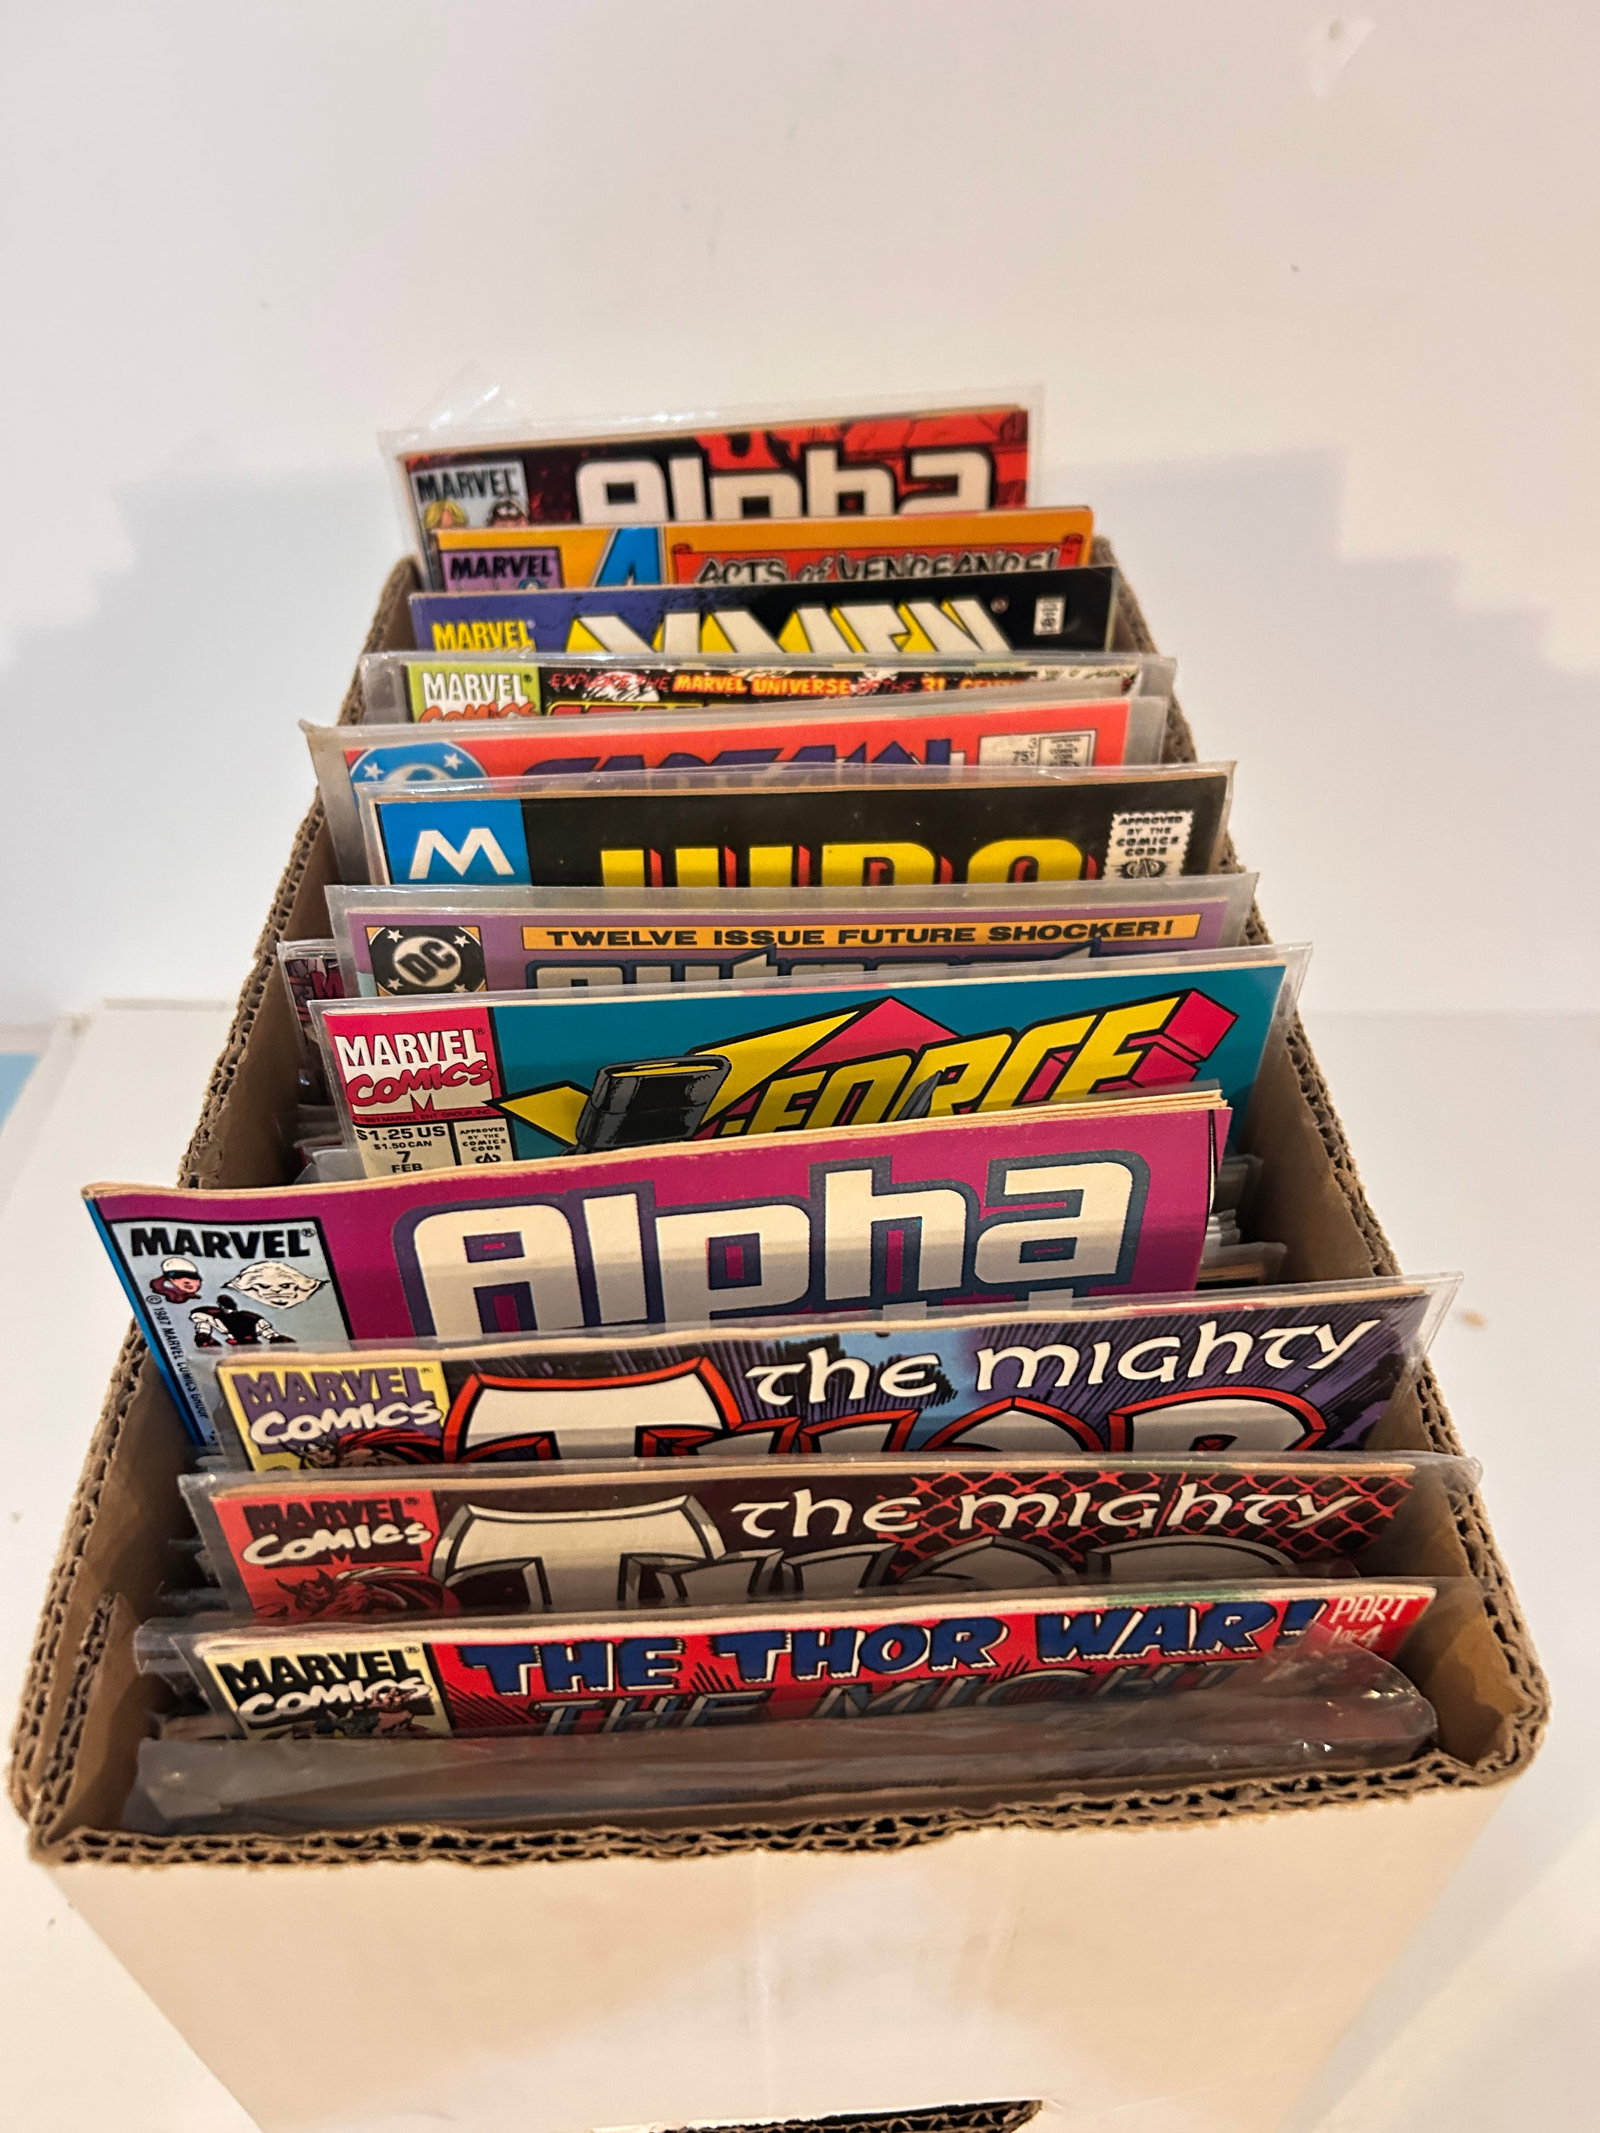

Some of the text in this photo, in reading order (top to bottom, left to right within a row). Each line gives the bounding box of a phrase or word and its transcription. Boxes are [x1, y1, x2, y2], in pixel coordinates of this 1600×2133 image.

[416, 470, 518, 501] MARVEL
[450, 555, 553, 580] MARVEL
[698, 557, 789, 585] ACTS
[432, 620, 536, 650] MARVEL
[423, 673, 529, 702] MARVEL
[672, 674, 747, 694] MARVEL
[752, 676, 851, 696] UNIVERSE
[1119, 816, 1183, 825] APPROVED
[1116, 836, 1179, 847] COMICS
[1125, 847, 1168, 857] CODE
[546, 919, 1174, 947] TWELVE ISSUE FUTURE SHOCKER!
[396, 940, 457, 984] DC
[334, 1028, 487, 1067] MARVEL
[345, 1059, 495, 1107] COMICS
[355, 1126, 446, 1141] $1.25 US
[374, 1140, 432, 1150] $1.50 CAN
[460, 1127, 505, 1135] APPROVED
[462, 1138, 507, 1146] COMICS
[391, 1163, 423, 1173] FEB
[397, 1151, 412, 1163] 7
[130, 1226, 311, 1259] MARVEL
[154, 1307, 171, 1325] 1987
[231, 1367, 435, 1406] MARVEL
[251, 1399, 443, 1445] COMICS
[243, 1497, 420, 1534] MARVEL
[242, 1520, 433, 1565] COMICS
[1329, 1594, 1419, 1624] PART
[456, 1598, 1329, 1696] THE THOR WAR!
[1358, 1624, 1383, 1648] 4
[217, 1650, 423, 1694] MARVEL
[238, 1676, 431, 1724] COMICS
